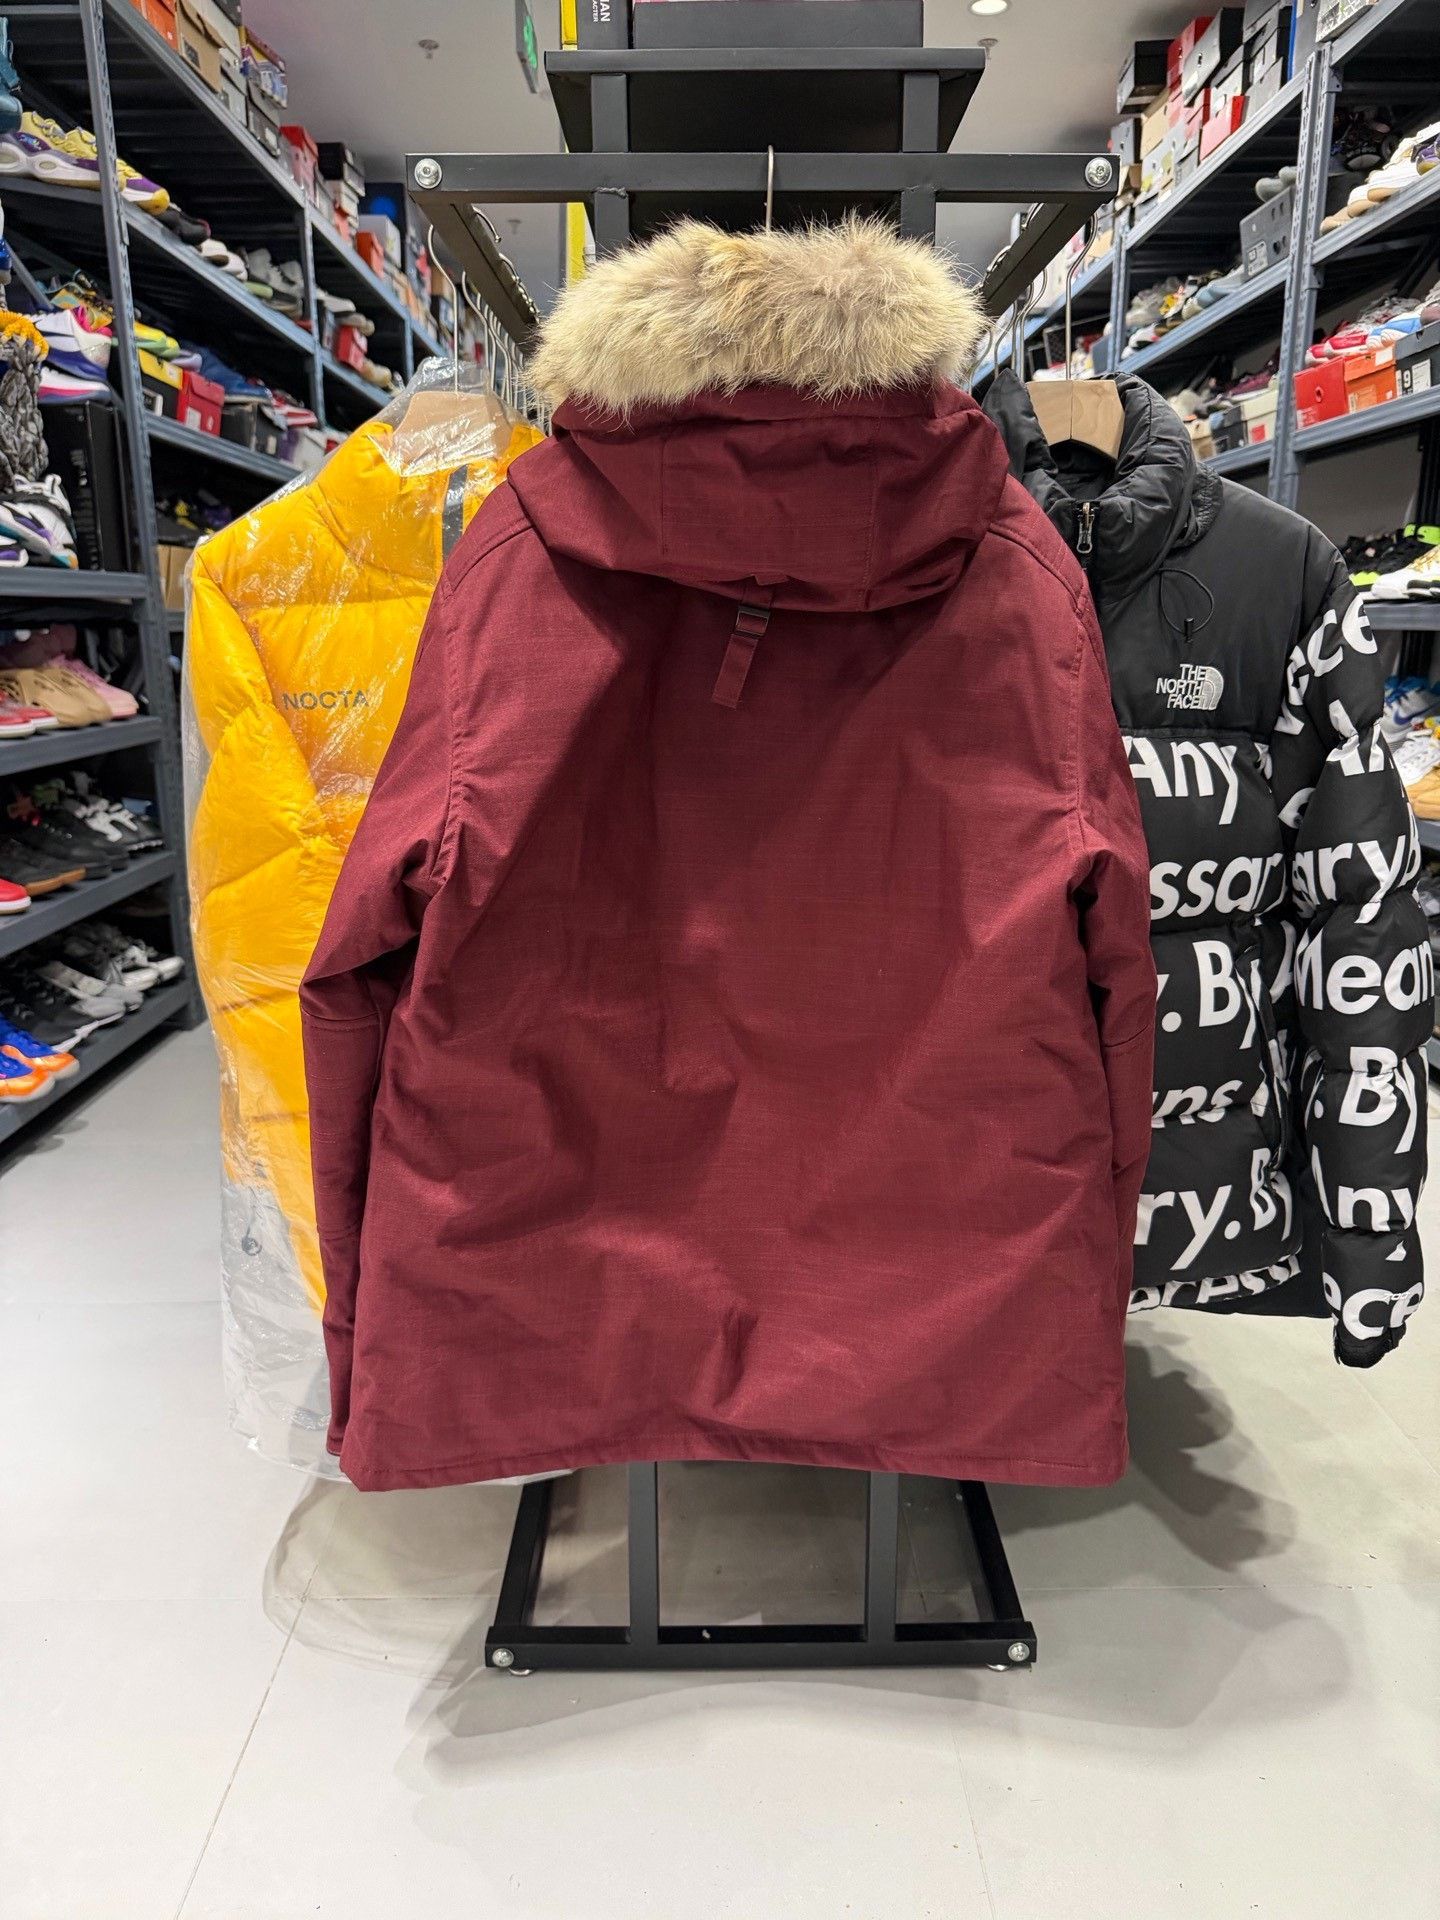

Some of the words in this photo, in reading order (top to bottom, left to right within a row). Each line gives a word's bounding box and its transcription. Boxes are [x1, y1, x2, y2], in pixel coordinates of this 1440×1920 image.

[1180, 663, 1207, 681] THE
[1156, 677, 1203, 695] NORTH
[283, 689, 369, 710] NOCTA
[1167, 693, 1203, 710] FACE
[1121, 735, 1238, 826] Any
[1338, 1046, 1418, 1155] By
